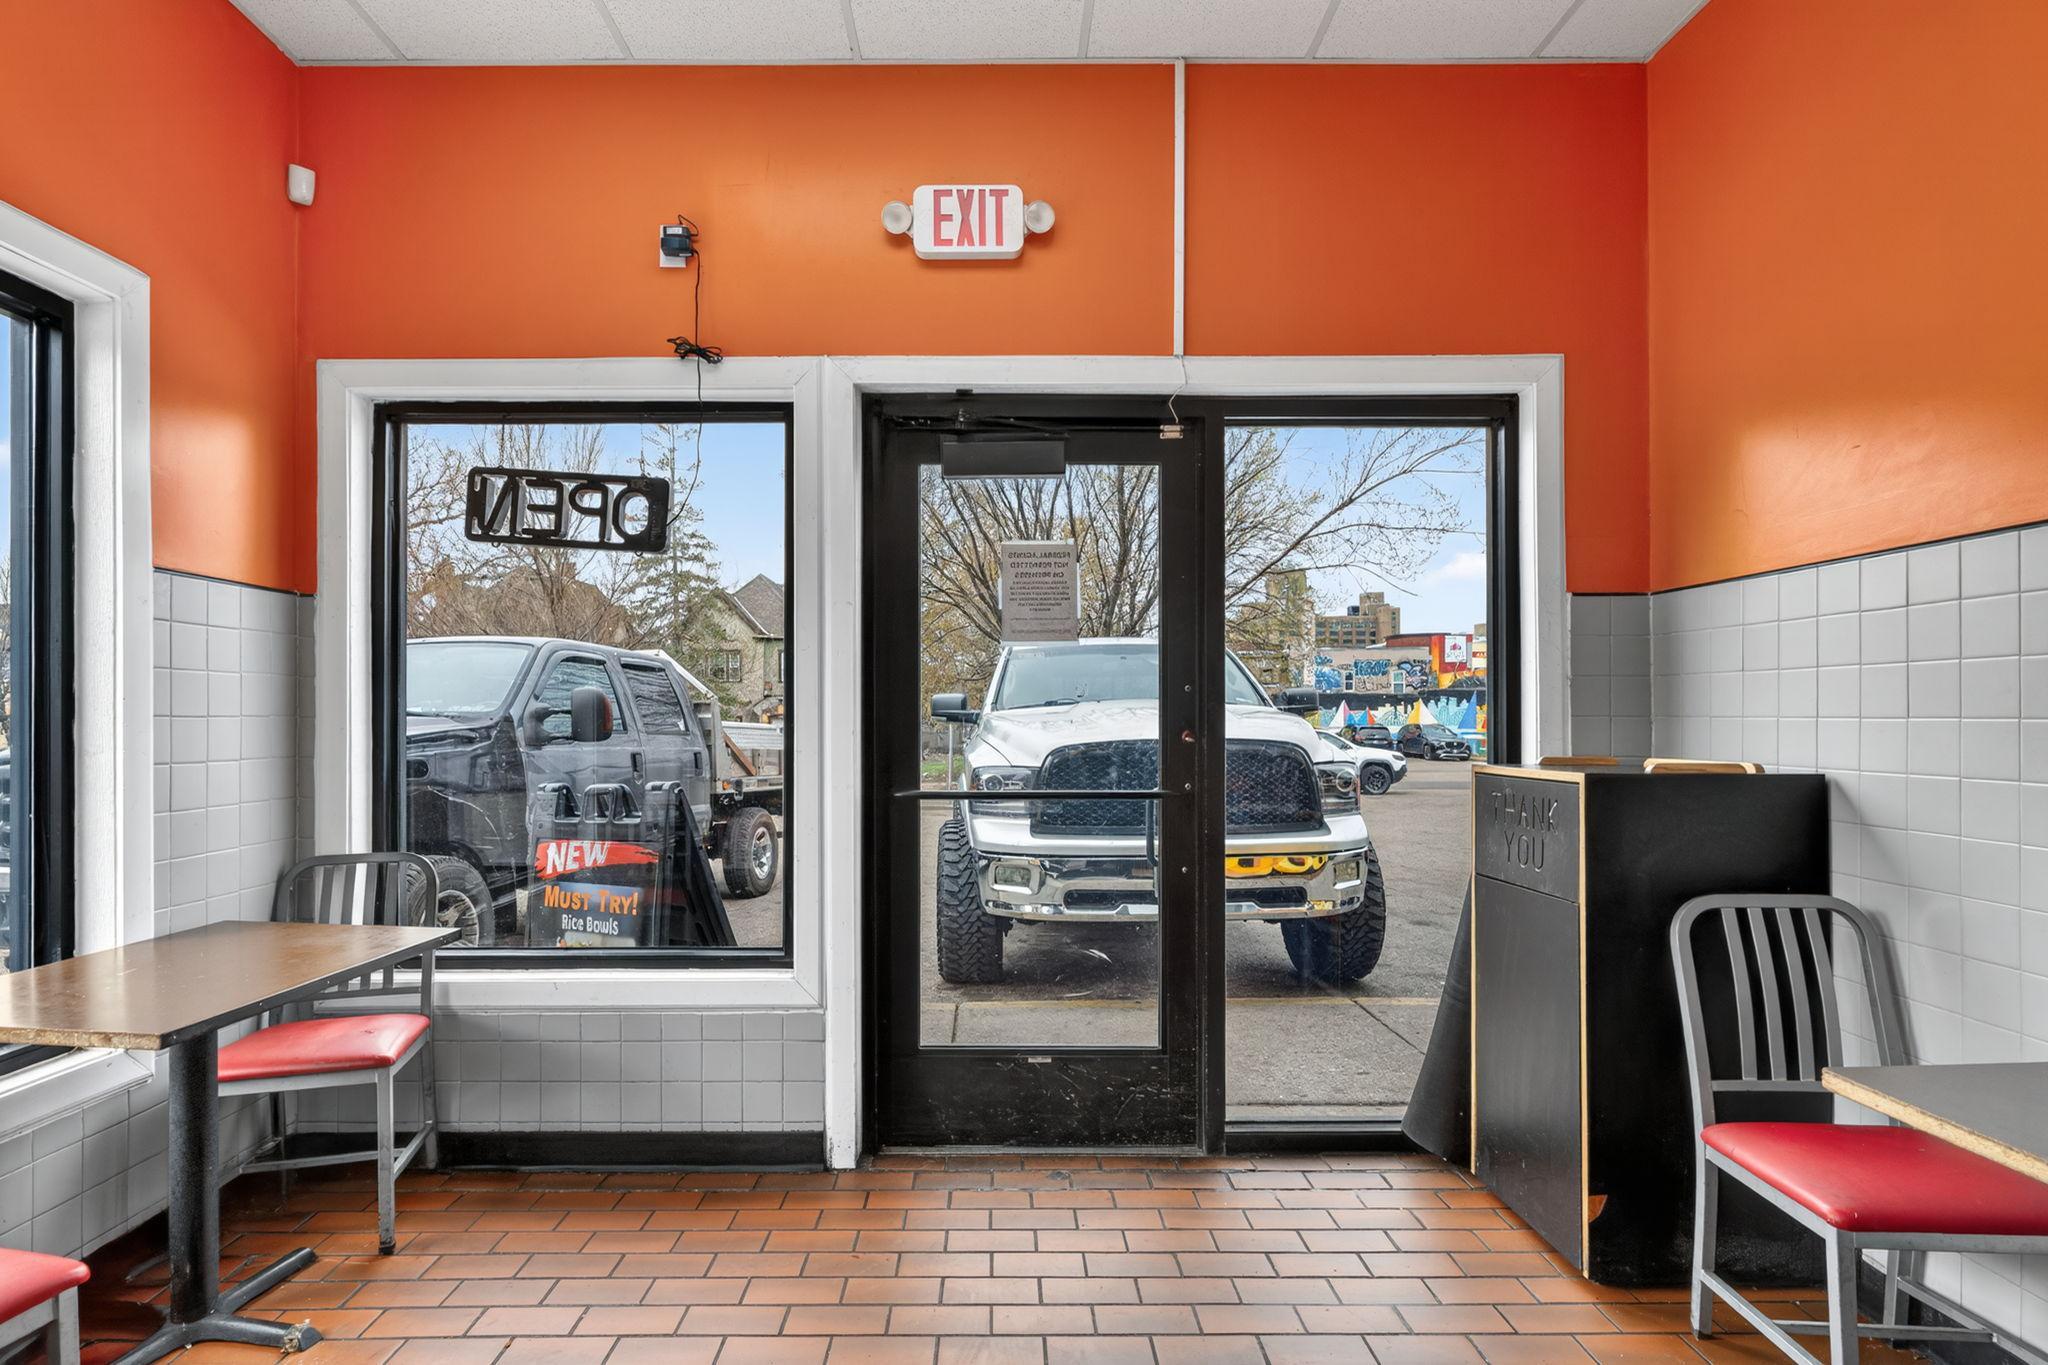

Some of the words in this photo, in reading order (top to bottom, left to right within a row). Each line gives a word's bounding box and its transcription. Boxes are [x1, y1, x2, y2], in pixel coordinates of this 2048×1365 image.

[933, 189, 1009, 247] EXIT
[1491, 789, 1558, 835] THANK
[545, 840, 609, 875] NEW
[1504, 830, 1545, 872] YOU
[561, 914, 584, 931] Rice
[586, 916, 619, 935] Bowls
